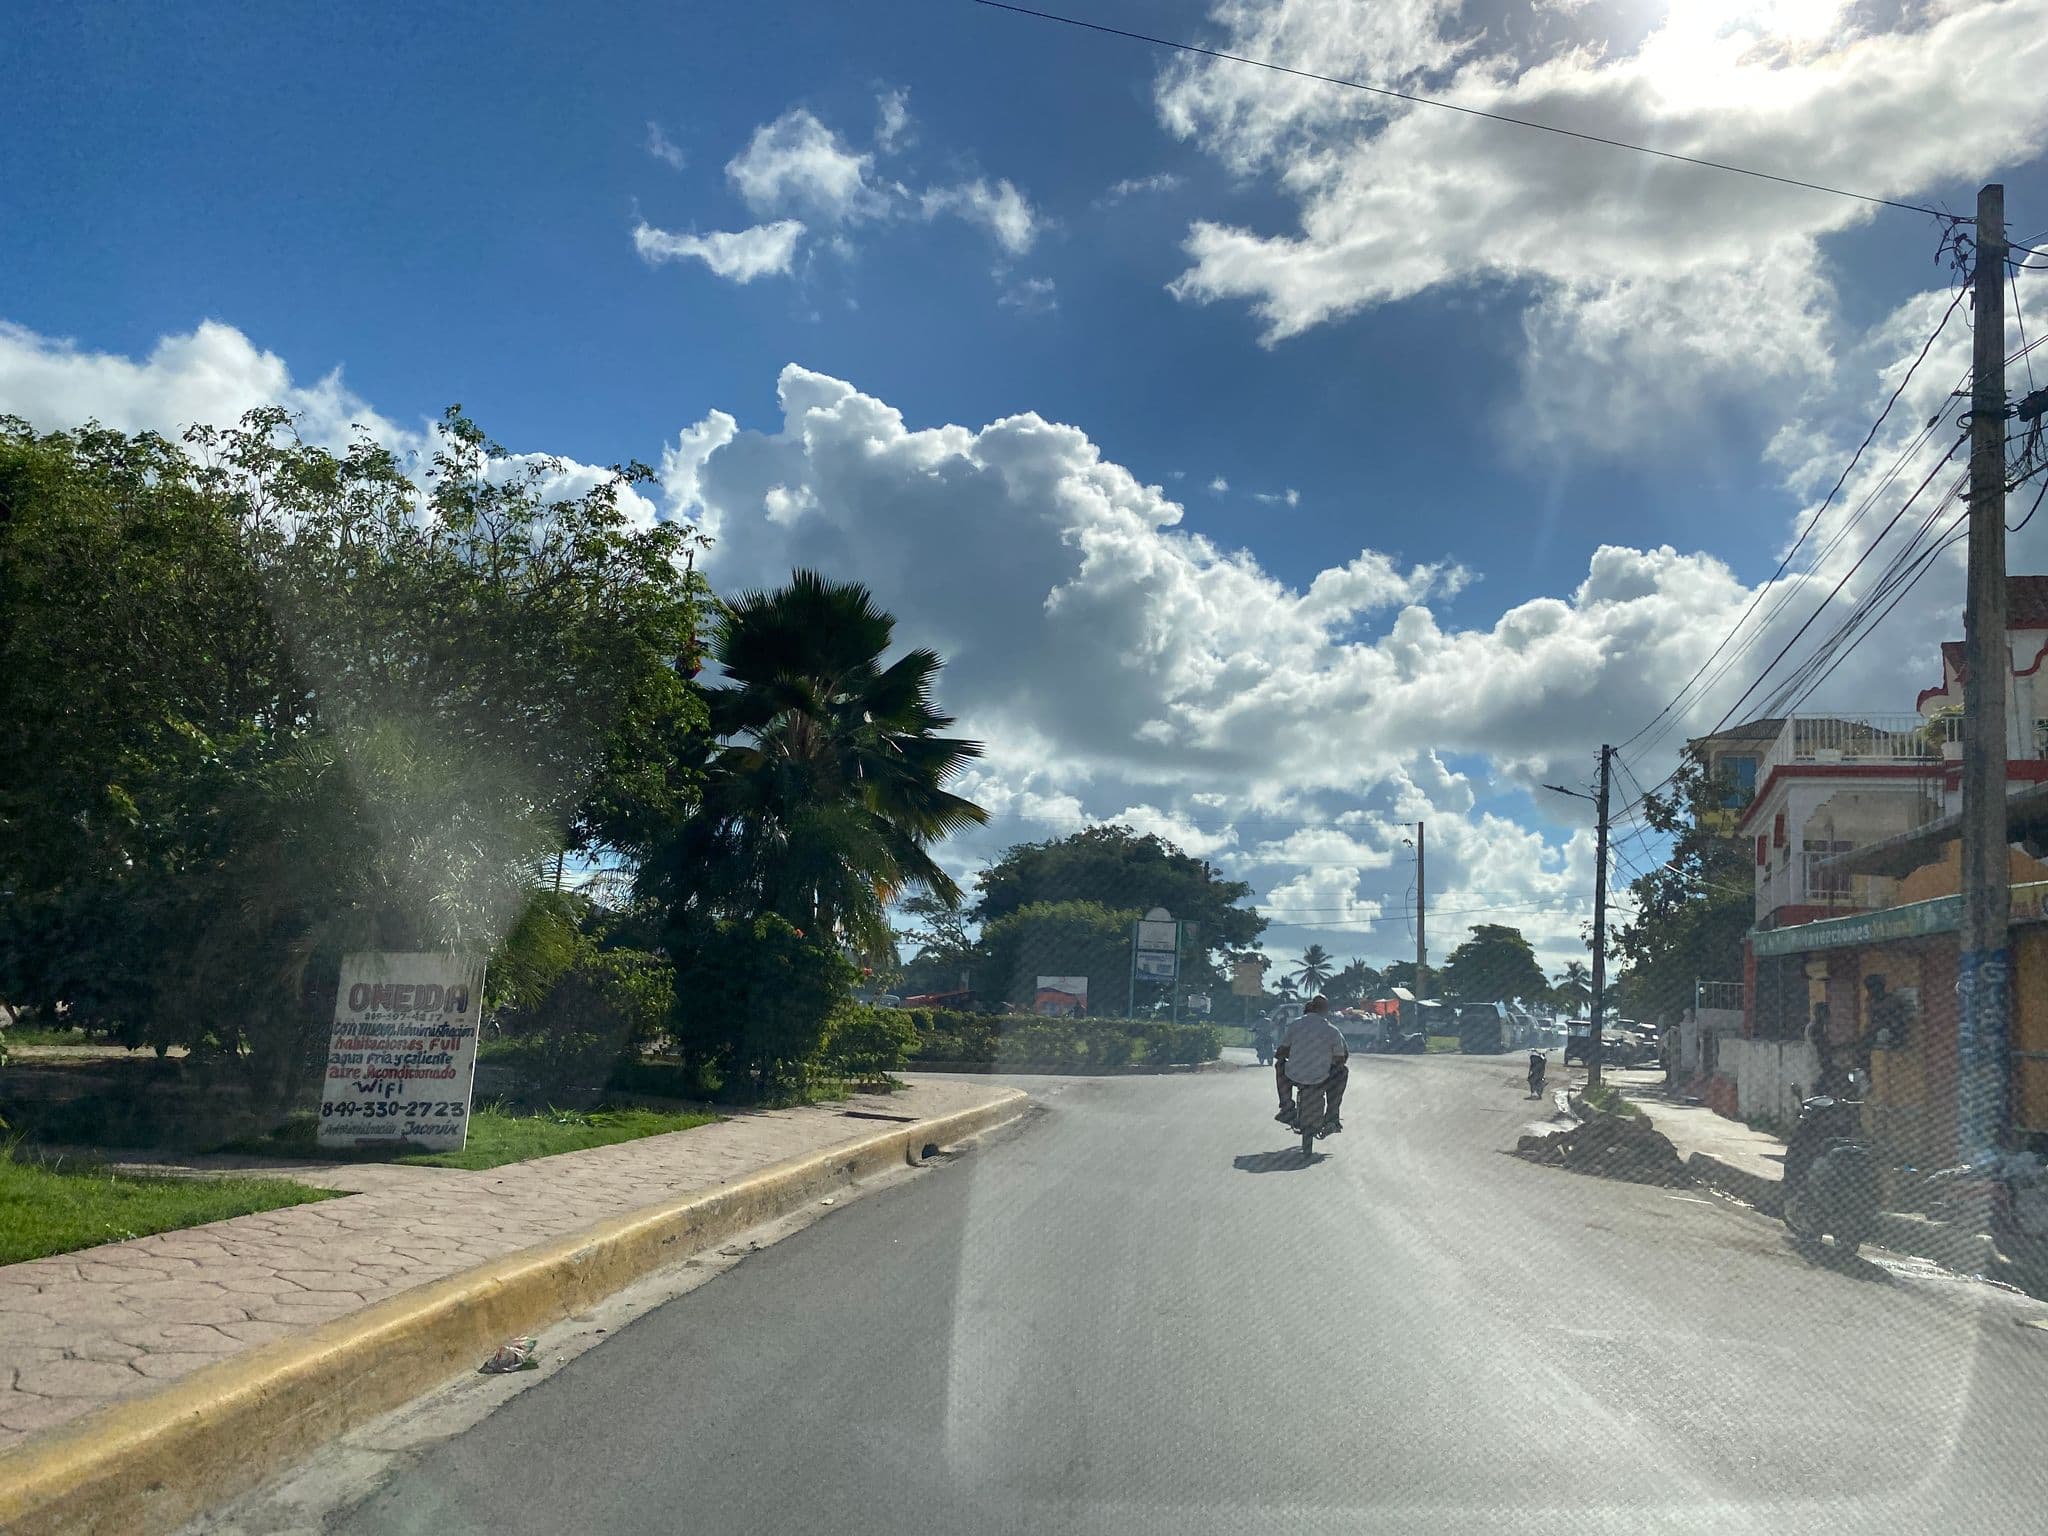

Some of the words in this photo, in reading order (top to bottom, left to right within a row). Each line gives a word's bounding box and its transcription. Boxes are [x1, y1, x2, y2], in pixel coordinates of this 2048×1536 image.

[349, 983, 468, 1013] ONEIDA
[330, 1053, 362, 1066] agua
[404, 1050, 452, 1065] caliente
[329, 1066, 360, 1079] aire
[321, 1101, 464, 1117] 849-330-2723
